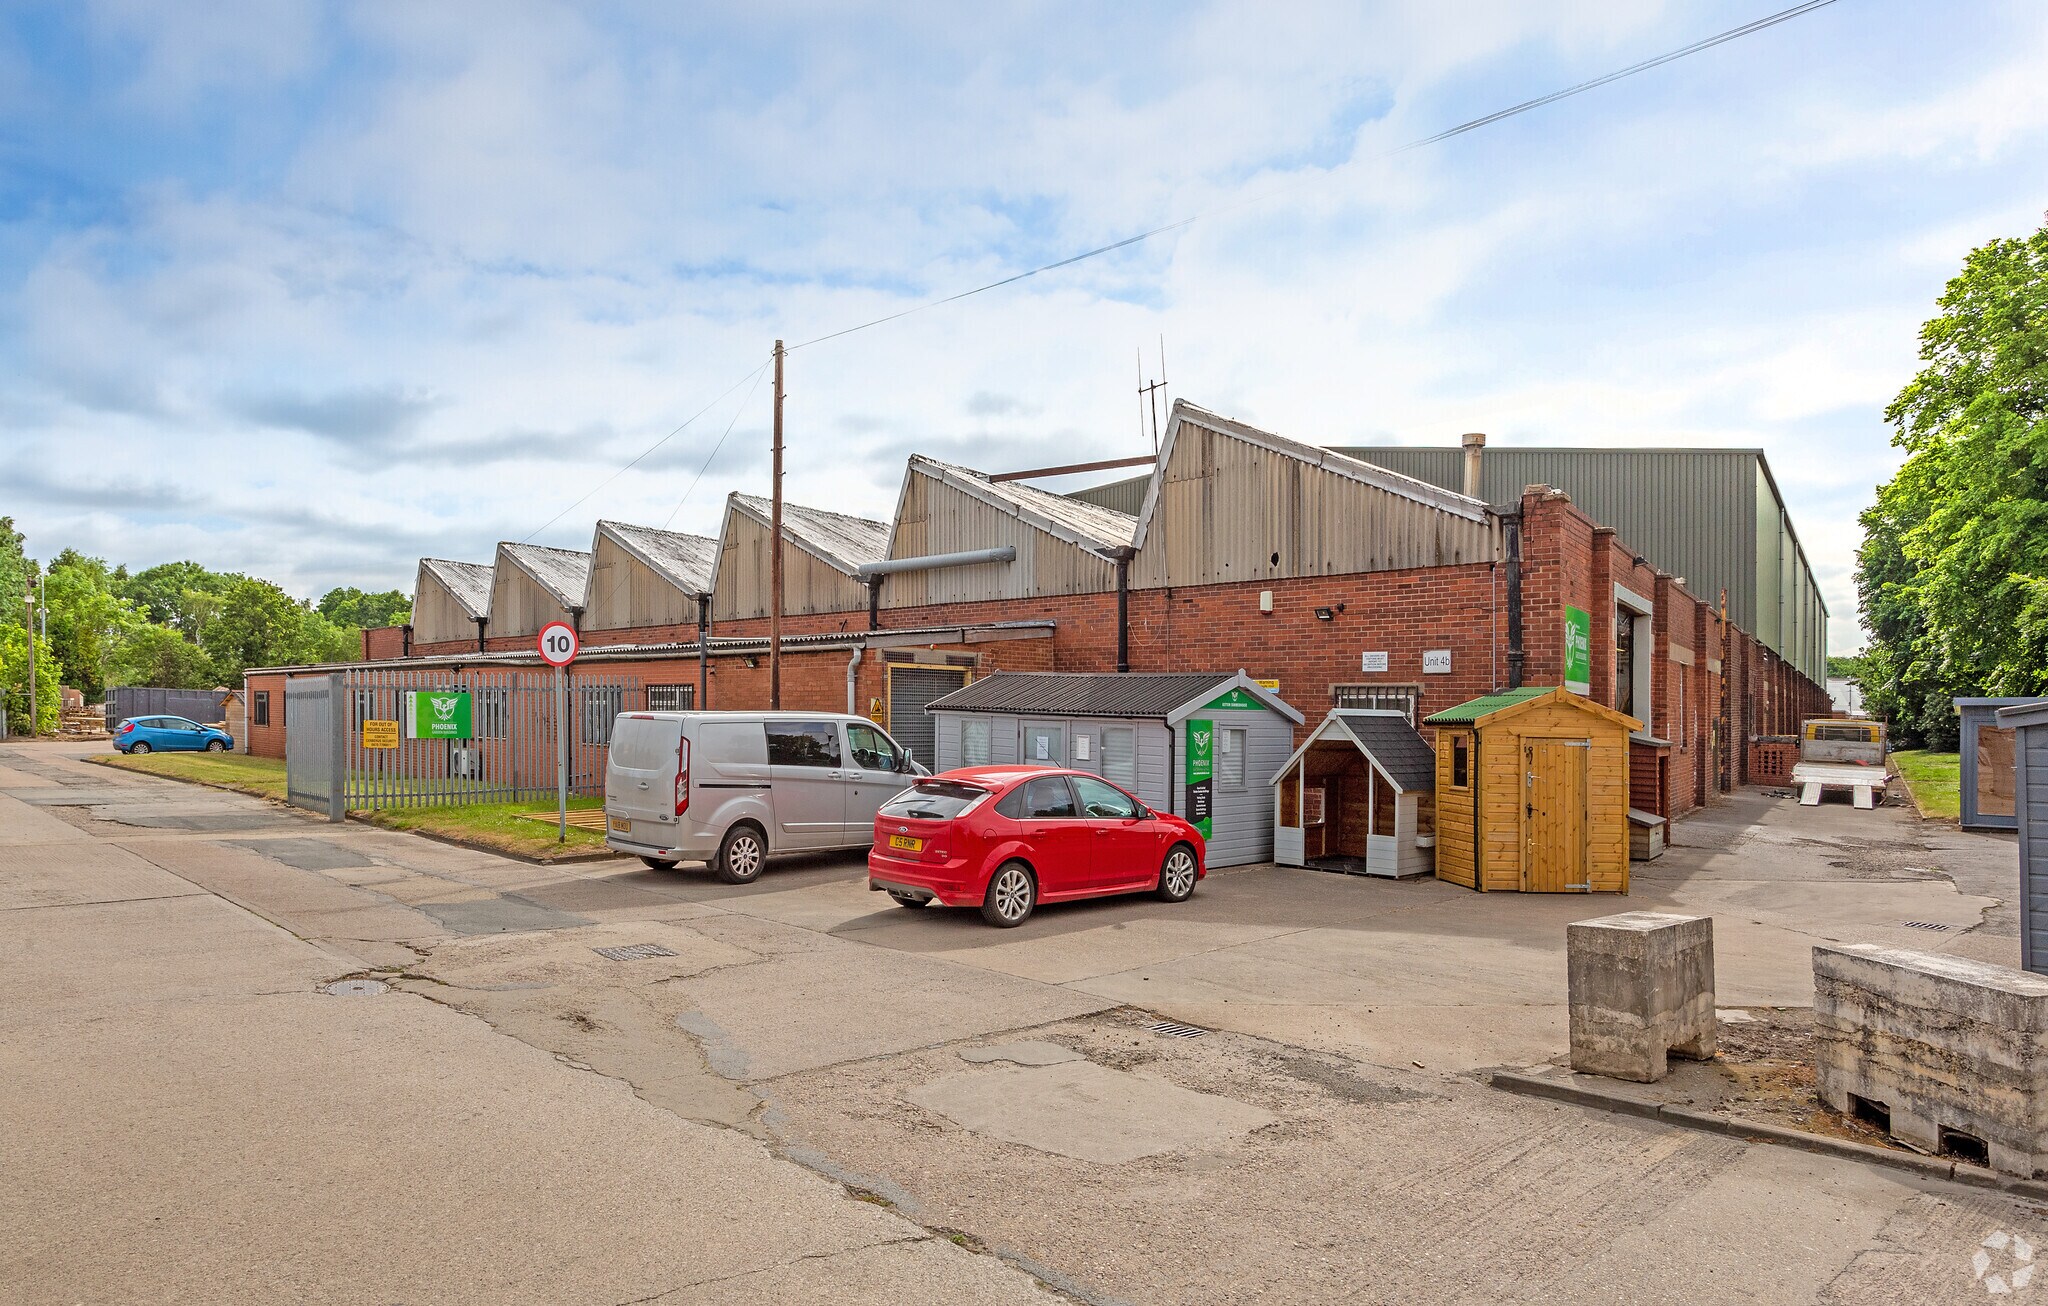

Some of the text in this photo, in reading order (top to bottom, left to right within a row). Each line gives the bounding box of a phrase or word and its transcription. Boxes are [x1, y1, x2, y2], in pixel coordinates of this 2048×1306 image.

[546, 635, 570, 653] 10
[1424, 656, 1450, 666] Unit 4b
